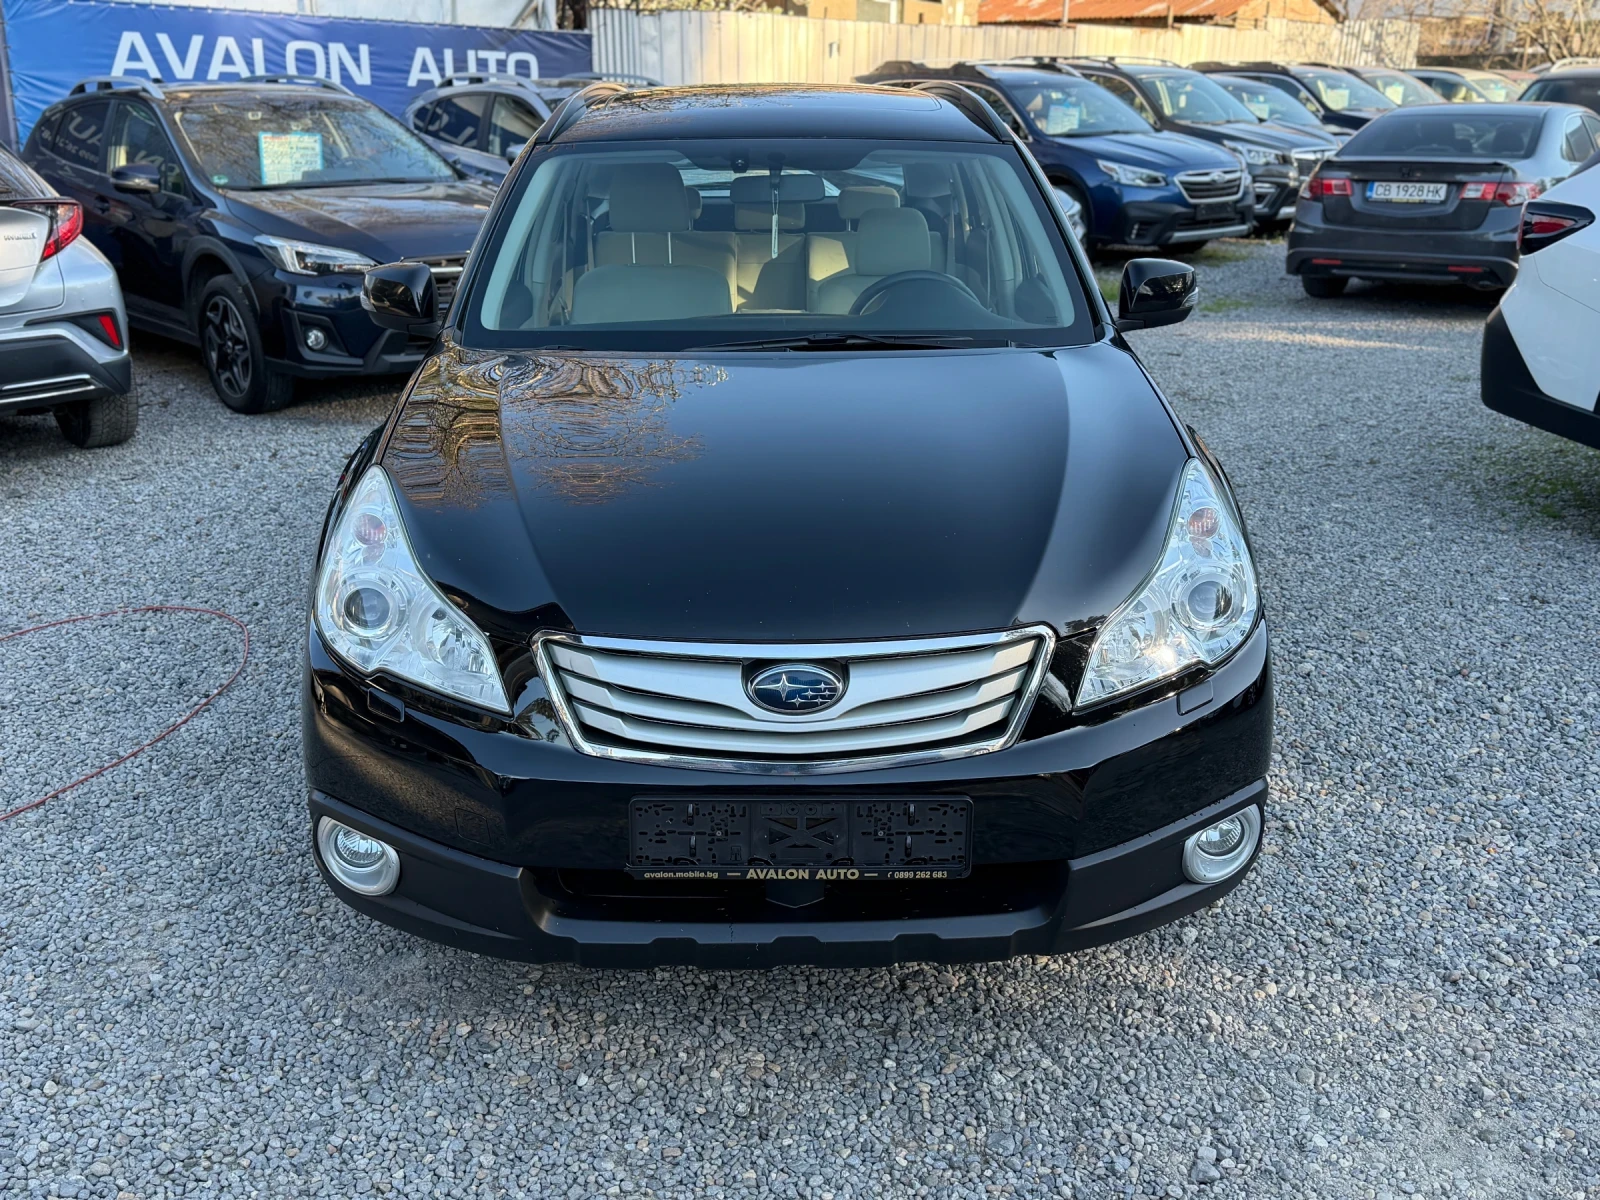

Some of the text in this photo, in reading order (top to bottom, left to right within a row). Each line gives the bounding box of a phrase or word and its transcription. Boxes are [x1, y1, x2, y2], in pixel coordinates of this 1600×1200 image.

[110, 31, 539, 87] AVALON AUTO
[1374, 184, 1444, 198] CB 1928 HK
[643, 869, 948, 880] avalon.mobile.bg AVALON AUTO 0899 262 683
